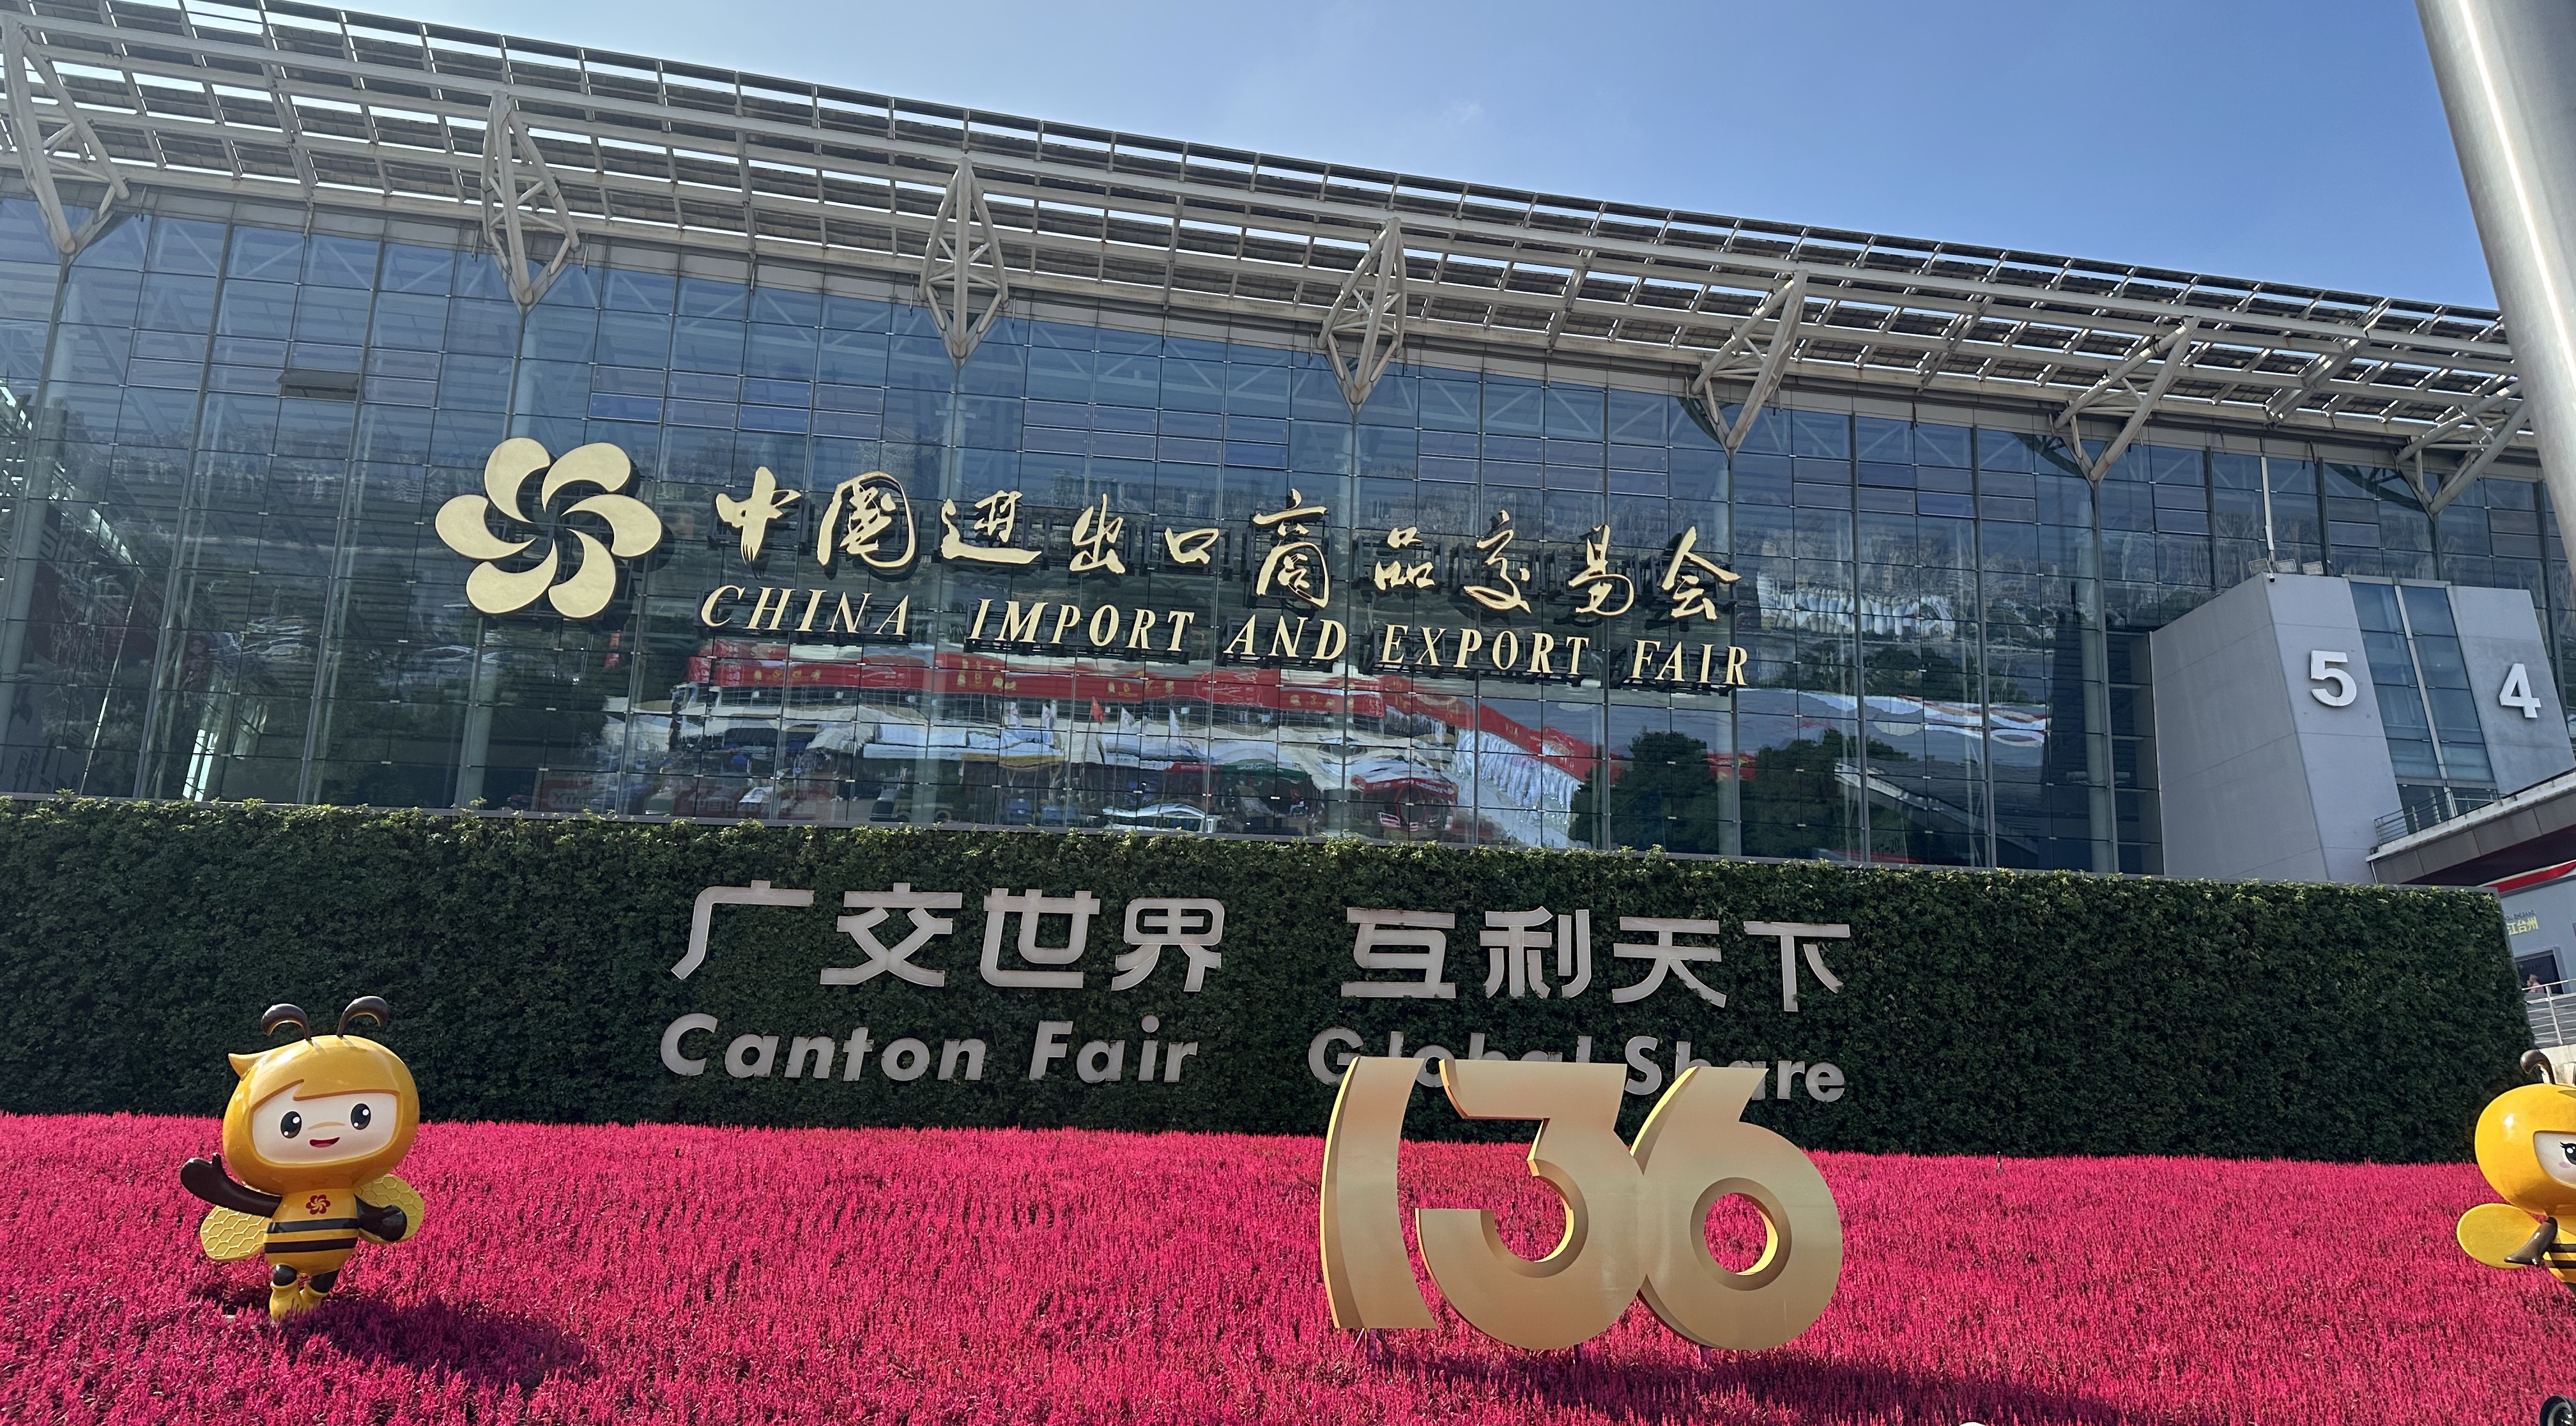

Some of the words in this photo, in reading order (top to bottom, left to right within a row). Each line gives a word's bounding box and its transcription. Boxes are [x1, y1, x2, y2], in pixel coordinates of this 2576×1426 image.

[700, 585, 910, 636] CHINA
[967, 598, 1195, 652] IMPORT
[1223, 614, 1347, 661] AND
[1379, 625, 1590, 676] EXPORT
[1630, 639, 1748, 686] FAIR
[2310, 650, 2357, 707] 5
[2499, 663, 2542, 719] 4
[671, 880, 1225, 992] 广交世界
[1340, 905, 1850, 1012] 互利天下
[660, 1013, 986, 1082] Canton
[1029, 1015, 1198, 1083] Fair
[1320, 1056, 1843, 1350] 136
